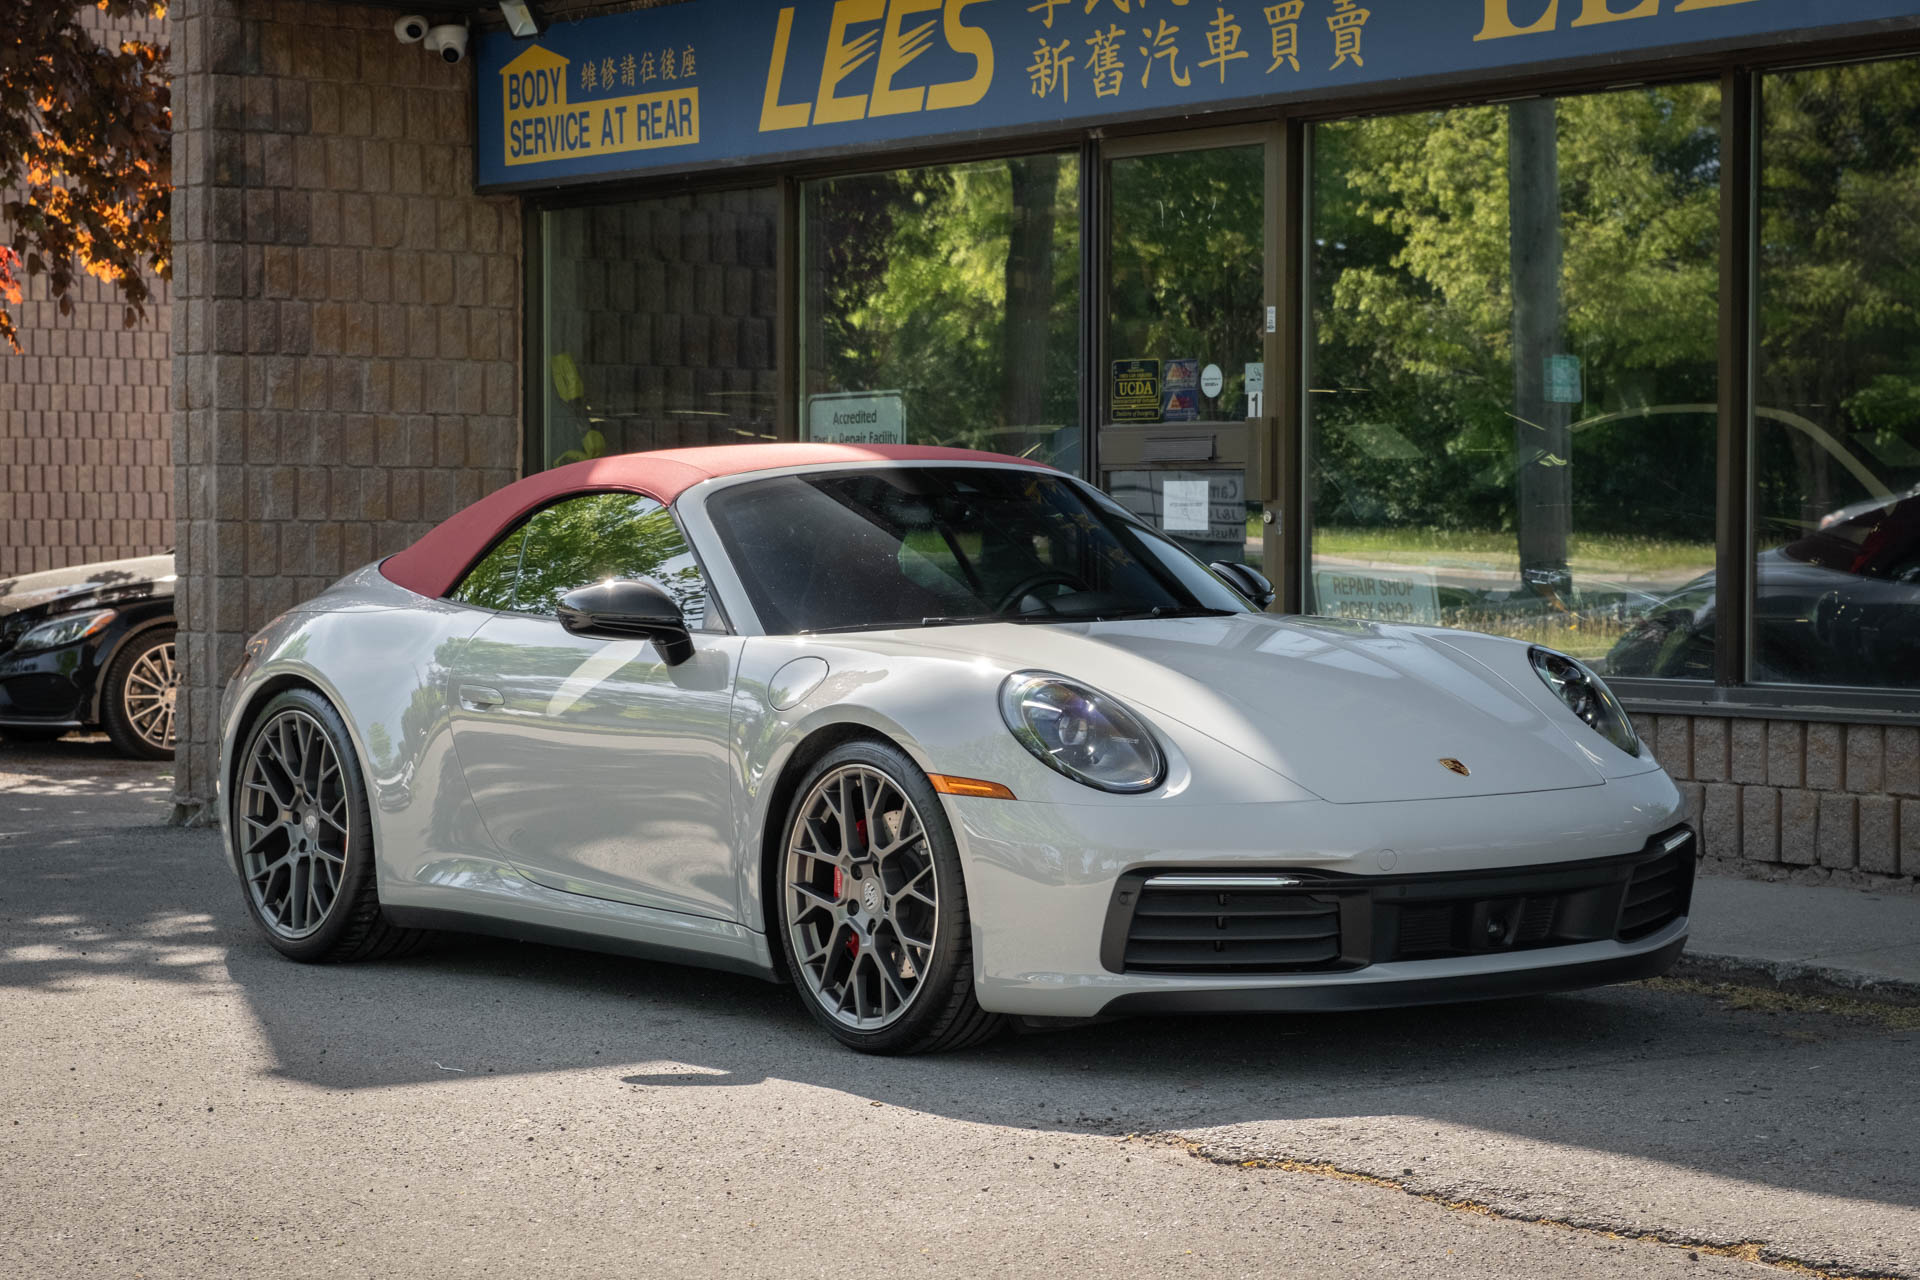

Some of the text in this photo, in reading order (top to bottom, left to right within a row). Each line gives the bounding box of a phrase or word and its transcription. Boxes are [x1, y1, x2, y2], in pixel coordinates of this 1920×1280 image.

[580, 44, 697, 93] 維修請往後座
[758, 0, 995, 132] LEES
[1026, 0, 1371, 105] 新舊汽車買賣
[508, 66, 562, 111] BODY
[509, 97, 693, 158] SERVICE AT REAR
[1118, 381, 1153, 396] UCDA
[832, 409, 878, 425] Accredited
[869, 430, 898, 444] Facility
[1332, 576, 1414, 596] REPAIR SHOP
